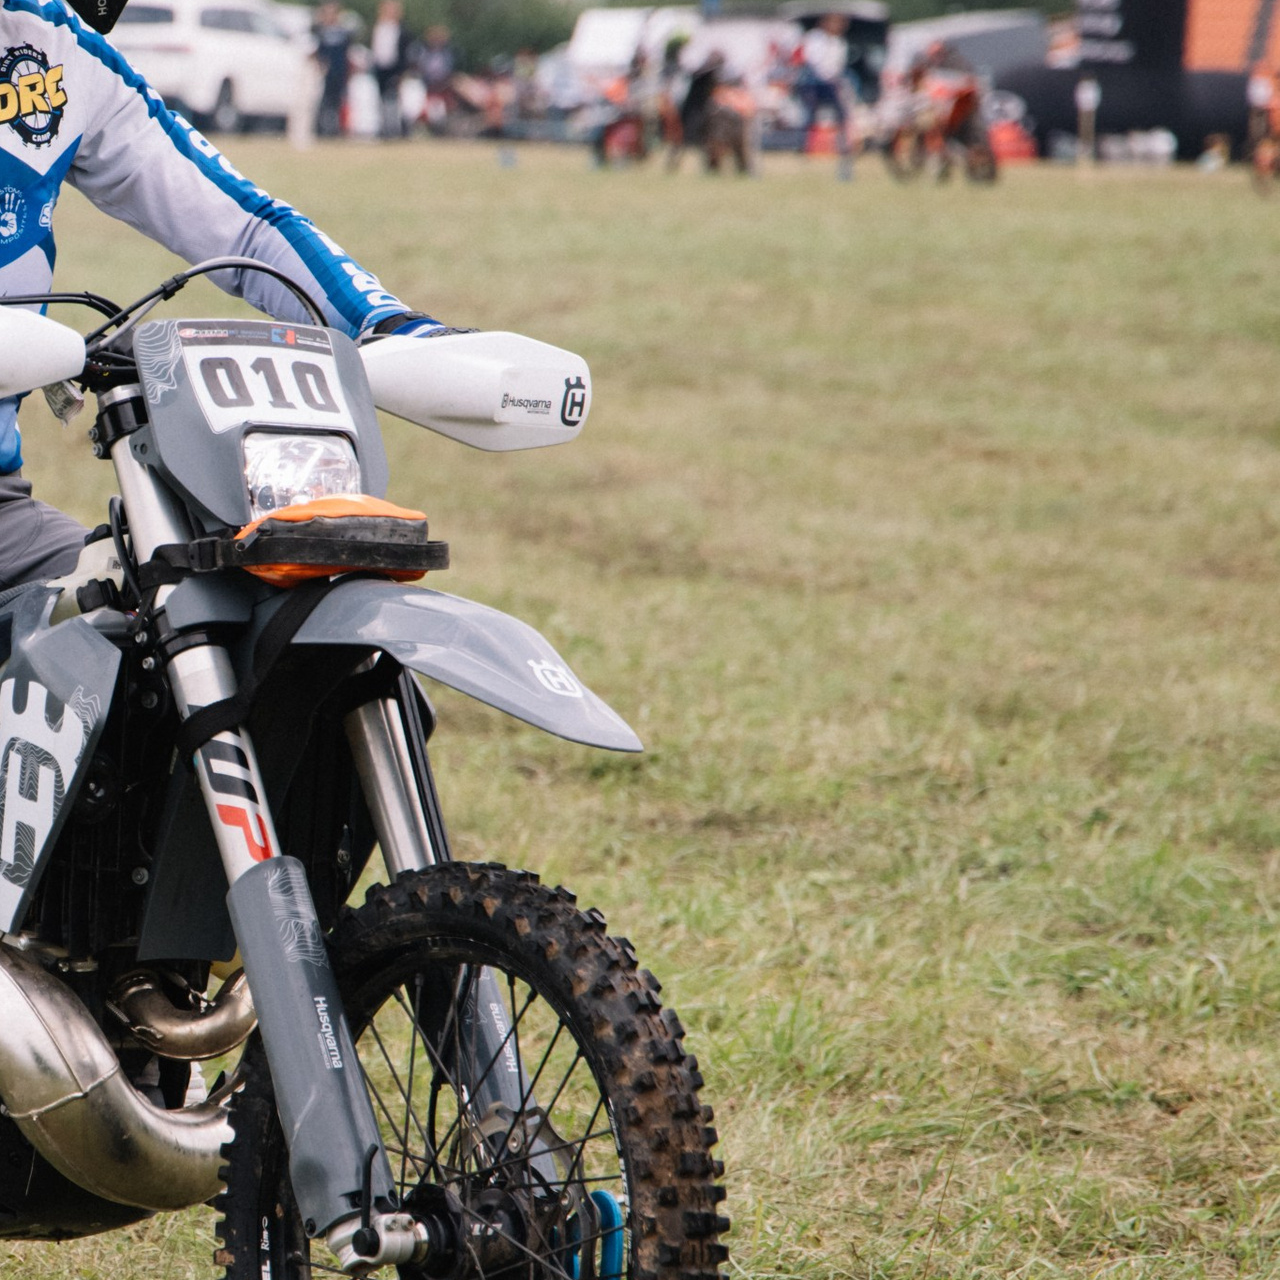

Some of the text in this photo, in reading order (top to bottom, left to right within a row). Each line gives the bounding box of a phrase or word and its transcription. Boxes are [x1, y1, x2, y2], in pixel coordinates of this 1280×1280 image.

[0, 47, 42, 72] DIRT RIDERS
[32, 132, 51, 142] CAMP
[199, 357, 341, 414] 010
[508, 396, 552, 411] Husqvarna
[313, 996, 343, 1069] Husqvarna
[261, 1229, 270, 1251] Rim
